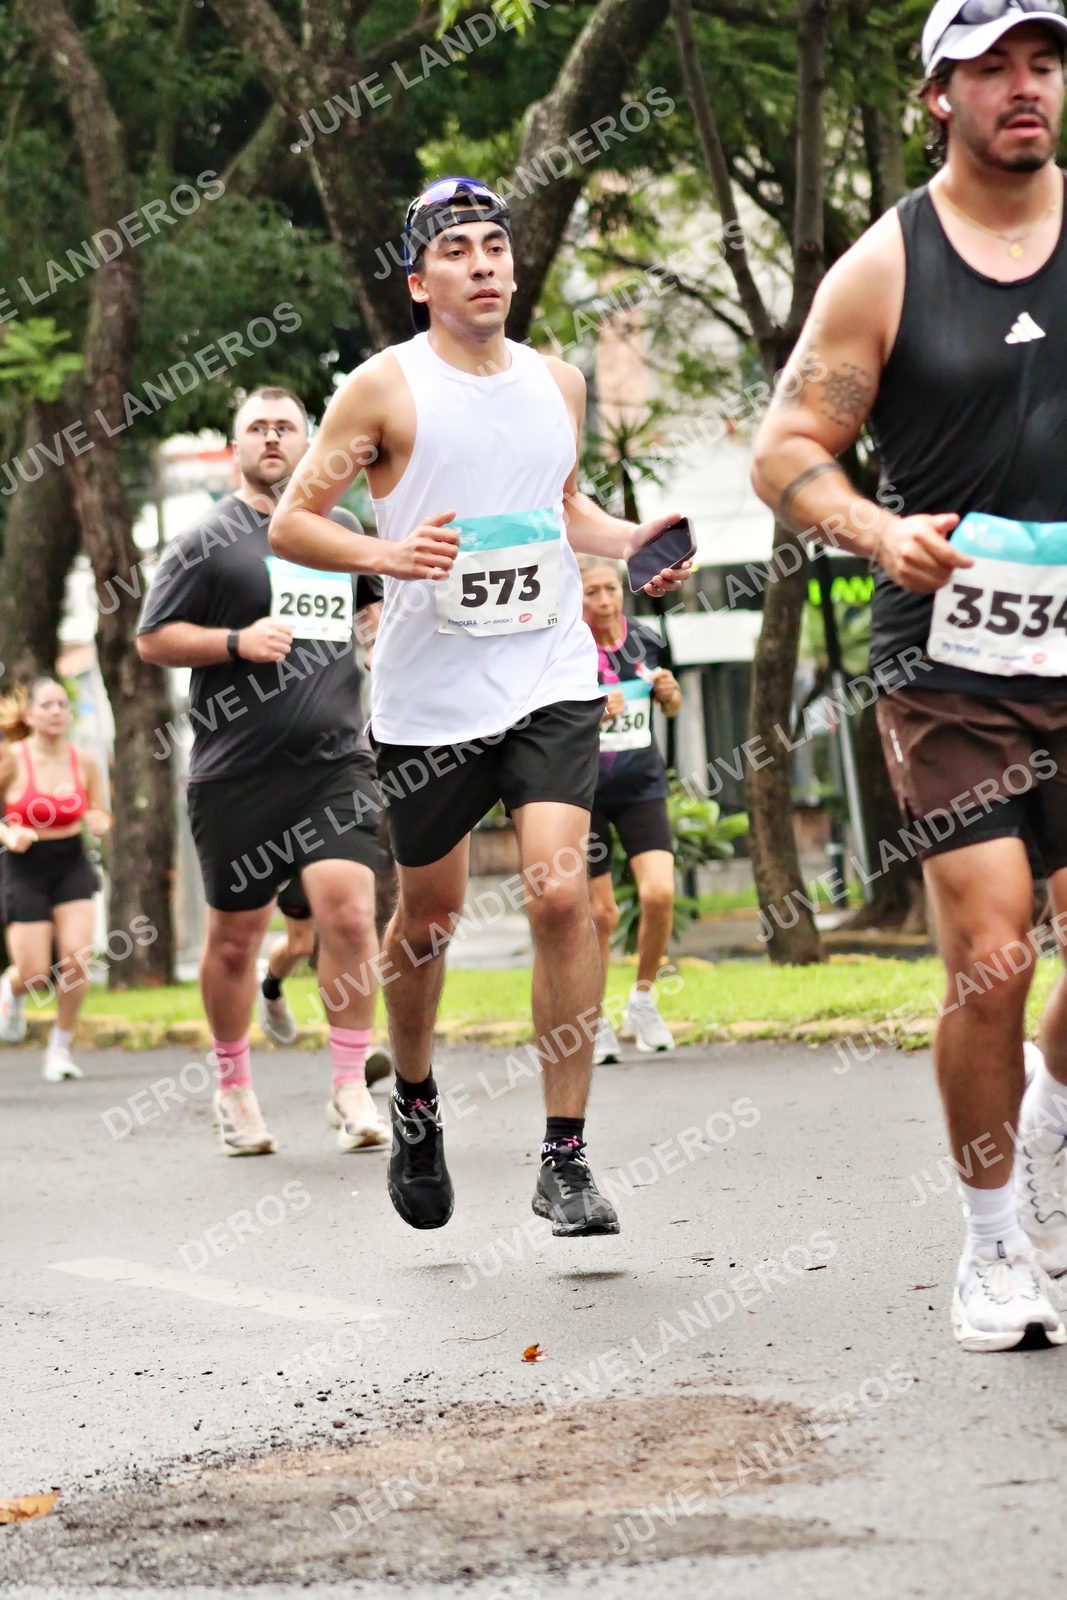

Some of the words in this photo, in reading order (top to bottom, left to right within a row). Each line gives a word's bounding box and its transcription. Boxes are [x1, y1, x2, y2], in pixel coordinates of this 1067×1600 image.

[460, 565, 541, 608] 573
[280, 592, 346, 620] 2692
[547, 618, 558, 626] 573
